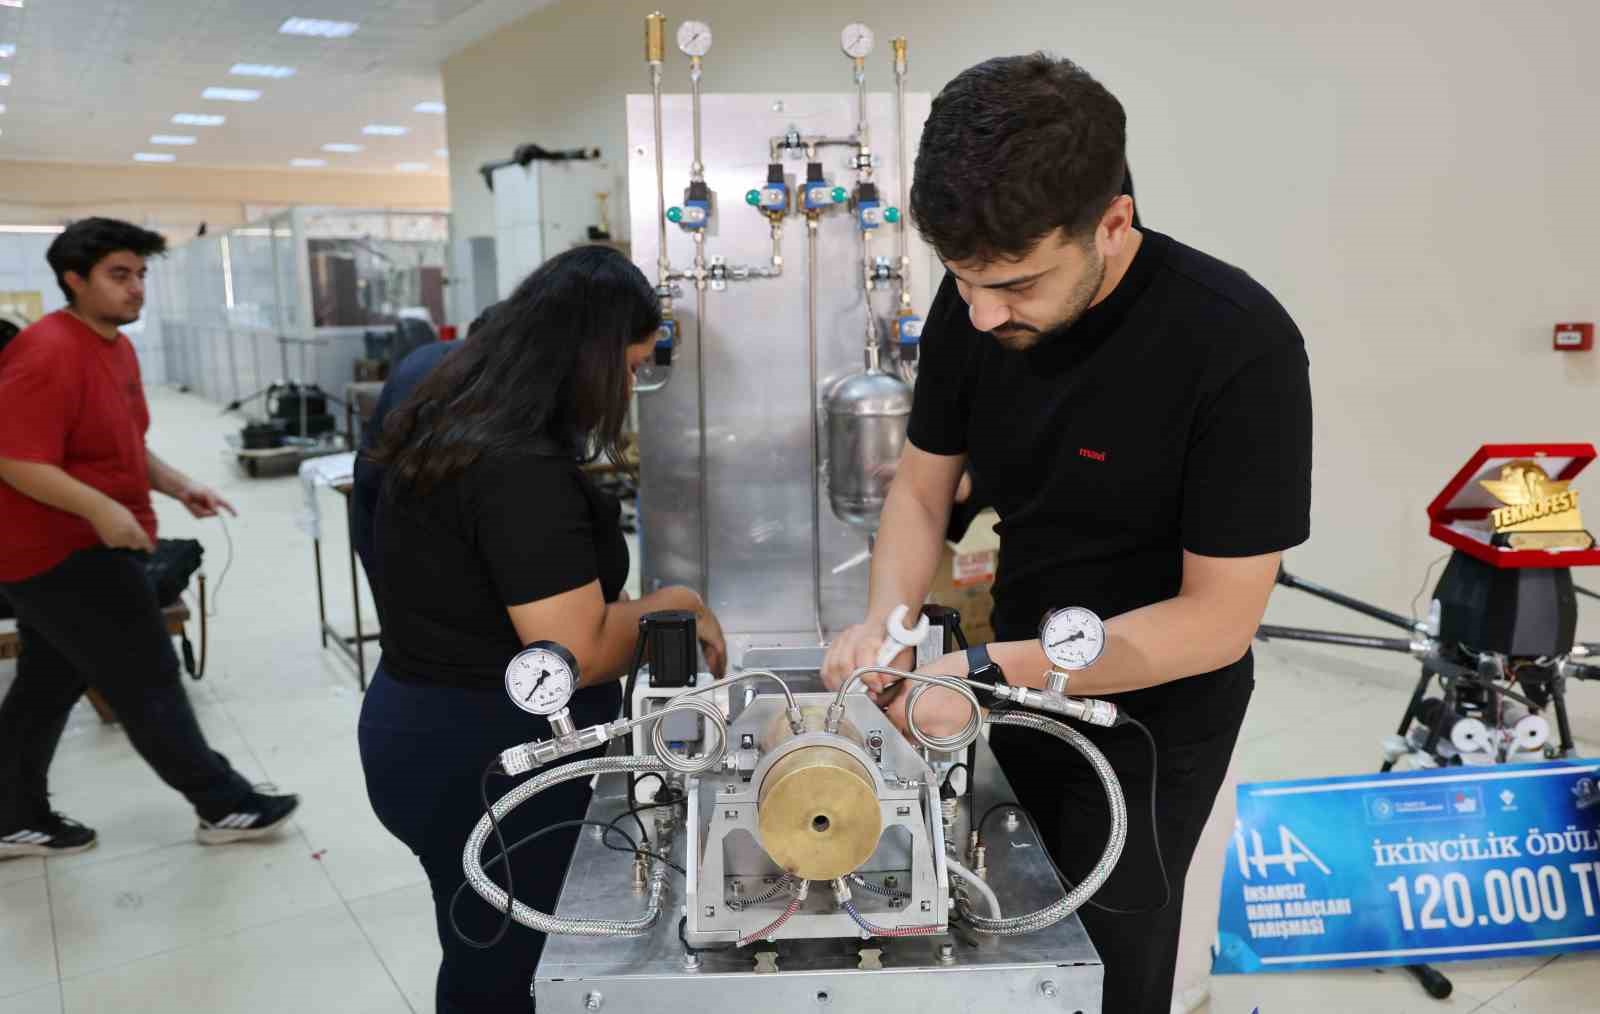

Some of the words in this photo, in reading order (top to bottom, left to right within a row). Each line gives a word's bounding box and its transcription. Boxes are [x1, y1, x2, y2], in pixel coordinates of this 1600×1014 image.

[1492, 491, 1579, 530] TEKNOFEST
[1372, 832, 1521, 866] İKİNCİLİK
[1388, 865, 1567, 930] 120.000
